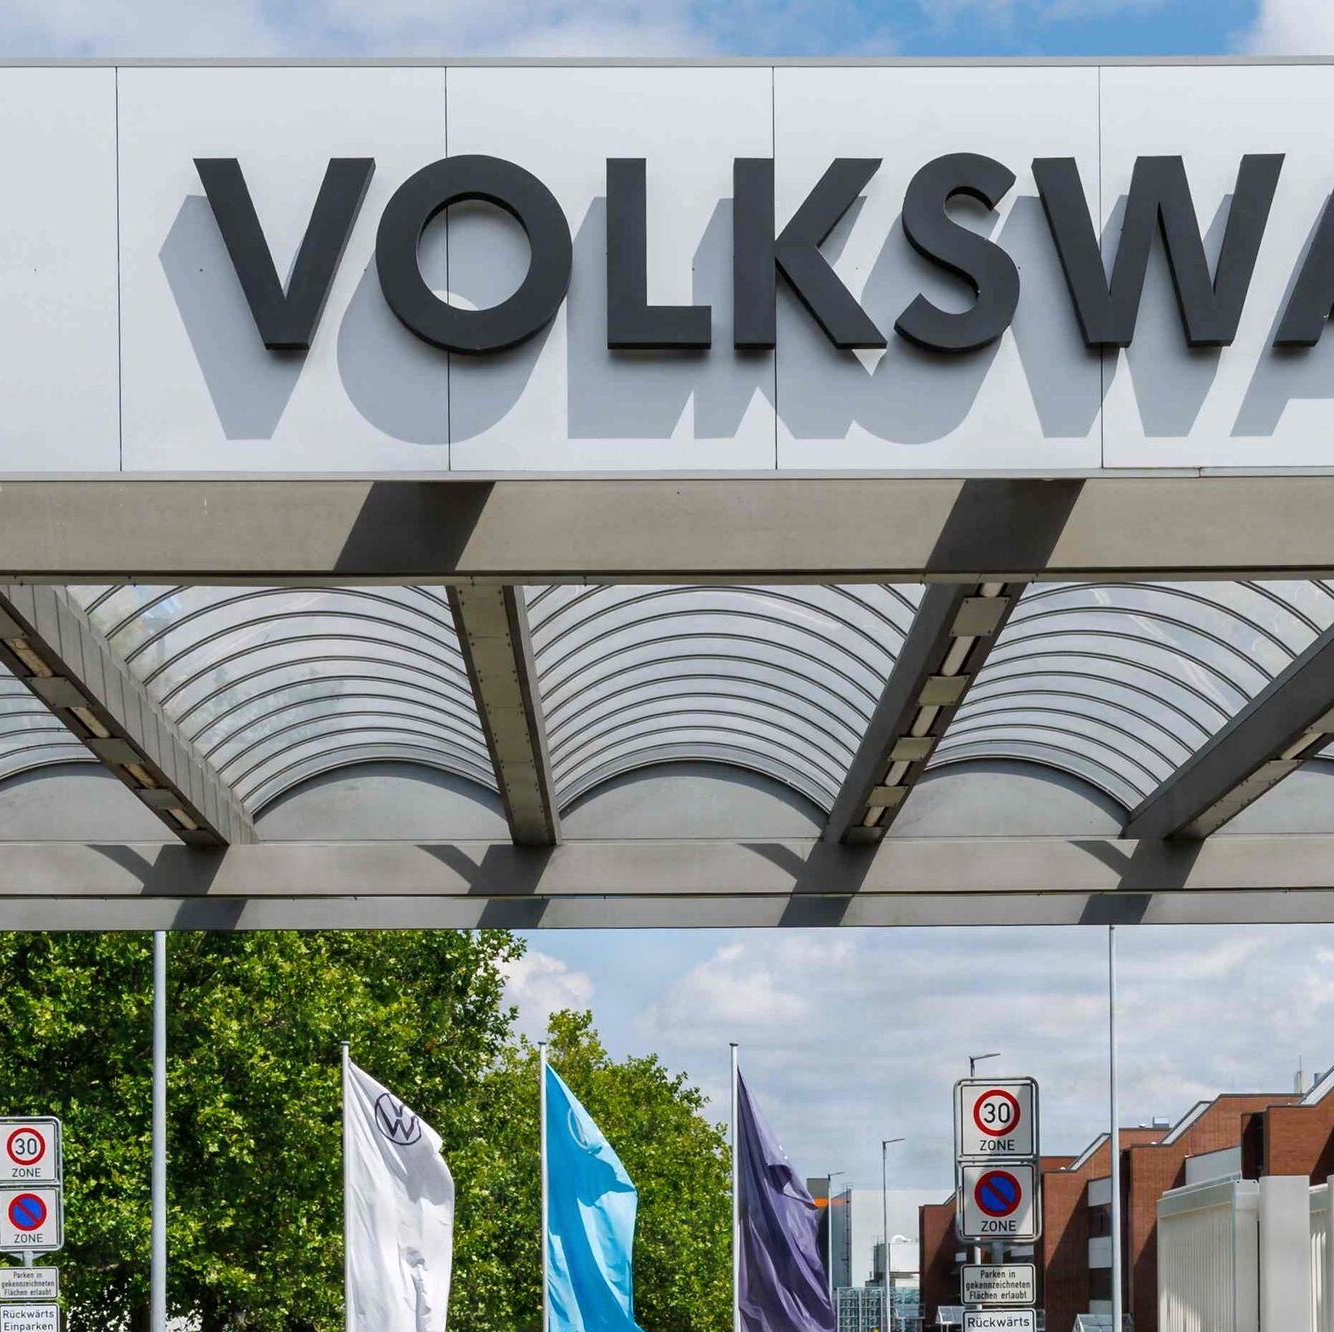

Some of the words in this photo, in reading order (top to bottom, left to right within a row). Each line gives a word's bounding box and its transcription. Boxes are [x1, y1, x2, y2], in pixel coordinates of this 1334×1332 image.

[983, 1102, 1011, 1124] 30
[15, 1137, 37, 1155] 30
[979, 1139, 1016, 1151] ZONE
[12, 1168, 41, 1178] ZONE
[981, 1220, 1017, 1232] ZONE
[14, 1233, 44, 1244] ZONE
[13, 1271, 34, 1279] Parken
[980, 1269, 1006, 1279] Parken
[1008, 1270, 1016, 1278] in
[1, 1280, 55, 1289] gekennzeichneten
[966, 1280, 1031, 1291] gekennzeichneten
[4, 1288, 28, 1296] Flächen
[29, 1288, 52, 1296] erlaubt
[969, 1290, 998, 1300] Flächen
[1000, 1290, 1027, 1299] erlaubt
[2, 1309, 55, 1319] Rückwärts
[3, 1321, 54, 1332] Einparken
[967, 1316, 1030, 1328] Rückwärts
